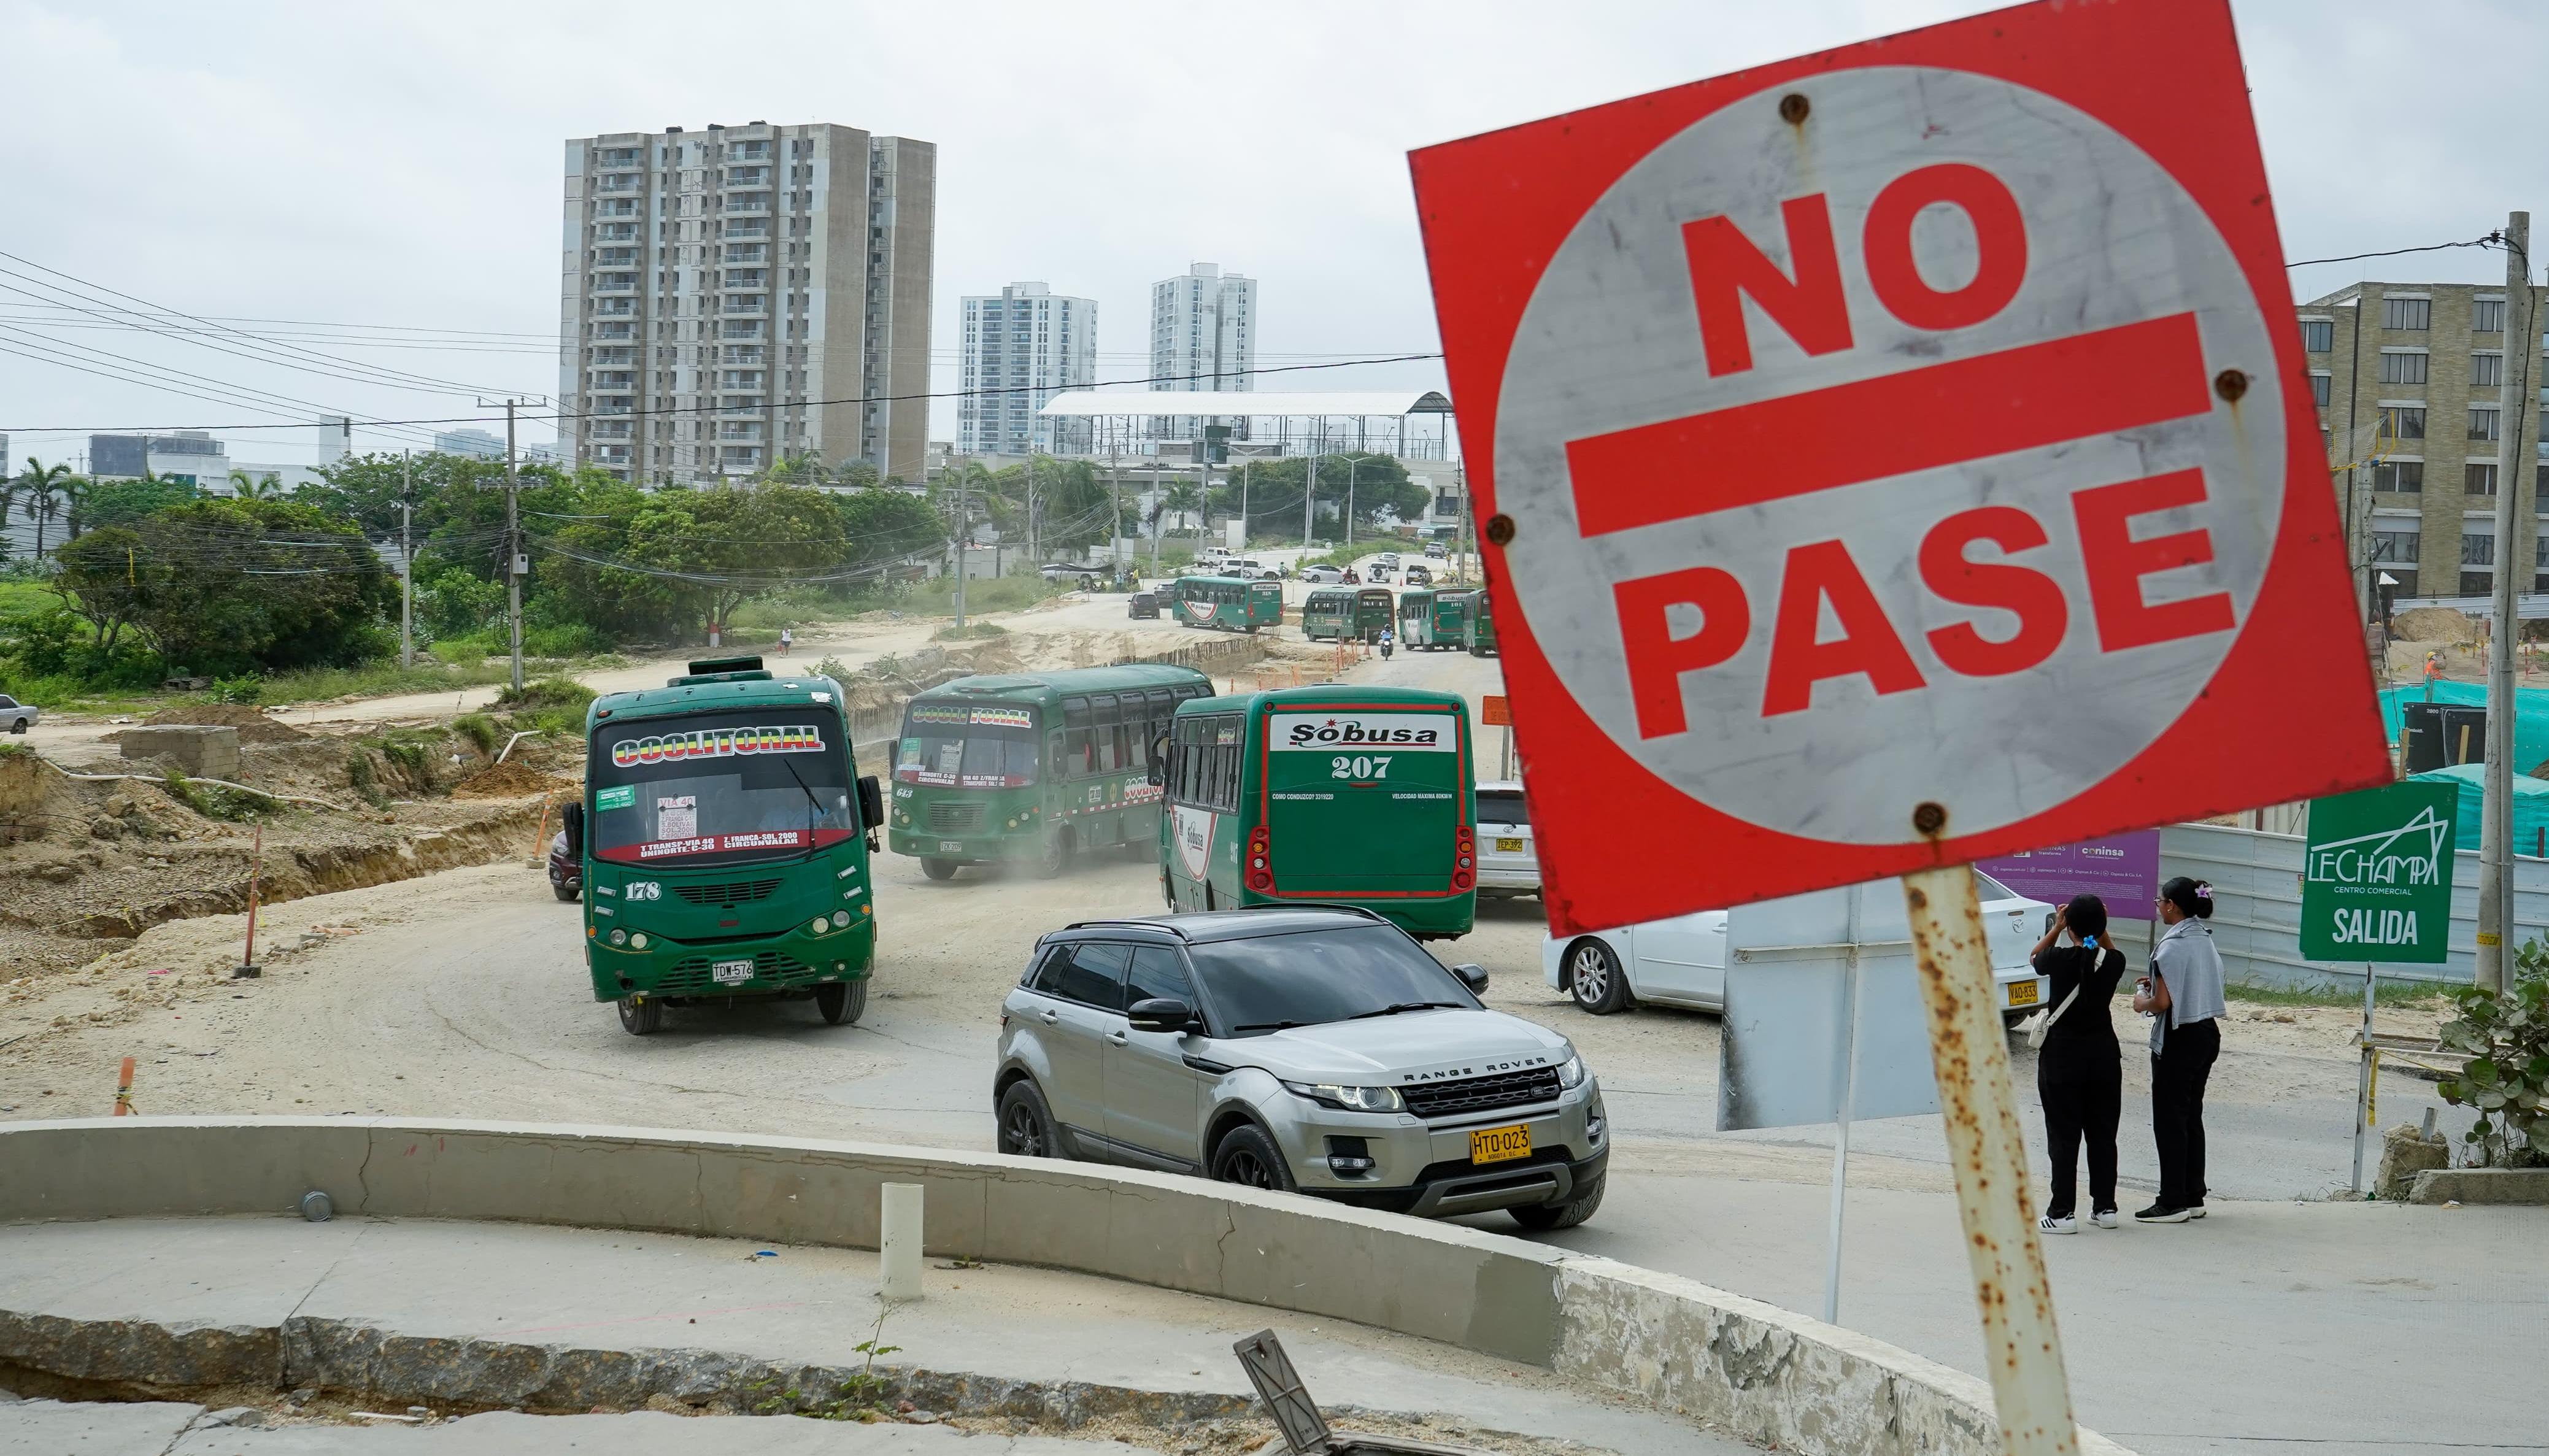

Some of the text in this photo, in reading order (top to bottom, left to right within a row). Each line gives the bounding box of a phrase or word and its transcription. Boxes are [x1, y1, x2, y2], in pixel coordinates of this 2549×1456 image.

[1681, 163, 2028, 379] NO
[1613, 466, 2235, 741] PASE
[1290, 723, 1438, 743] Sobusa
[612, 725, 826, 767] COOLITORAL
[1332, 755, 1393, 779] 207
[660, 797, 693, 807] VIA 40
[897, 787, 914, 798] 643
[724, 838, 798, 848] CIRCUNVALAR
[1187, 826, 1203, 847] Sobusa
[2081, 846, 2124, 857] coninsa
[625, 881, 662, 901] 178
[2334, 886, 2366, 895] CENTRO
[2332, 907, 2418, 946] SALIDA
[714, 964, 752, 977] TDW-576
[1403, 1057, 1547, 1081] RANGE ROVER
